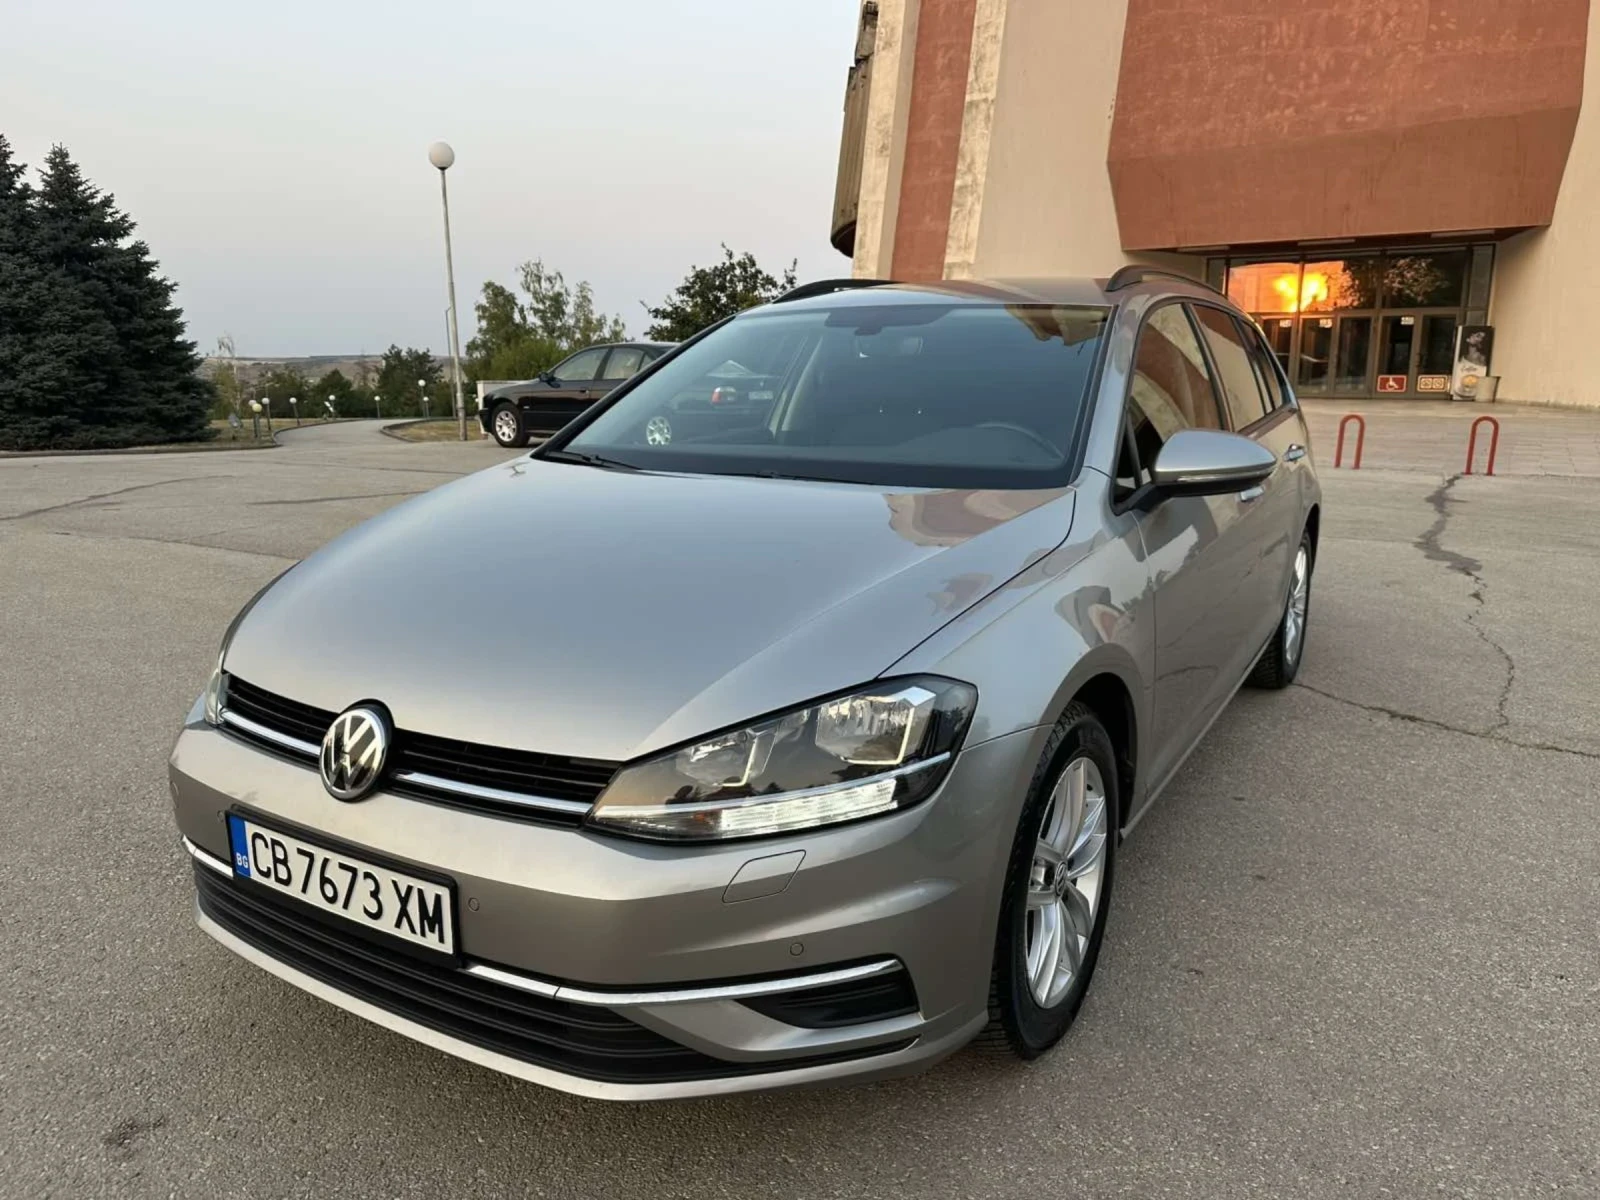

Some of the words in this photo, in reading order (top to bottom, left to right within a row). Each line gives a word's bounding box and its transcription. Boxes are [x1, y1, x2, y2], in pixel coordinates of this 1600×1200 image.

[323, 709, 384, 795] VW
[236, 852, 249, 869] BG
[251, 831, 292, 887] CB
[296, 847, 383, 920] 7673
[391, 879, 445, 944] XM
